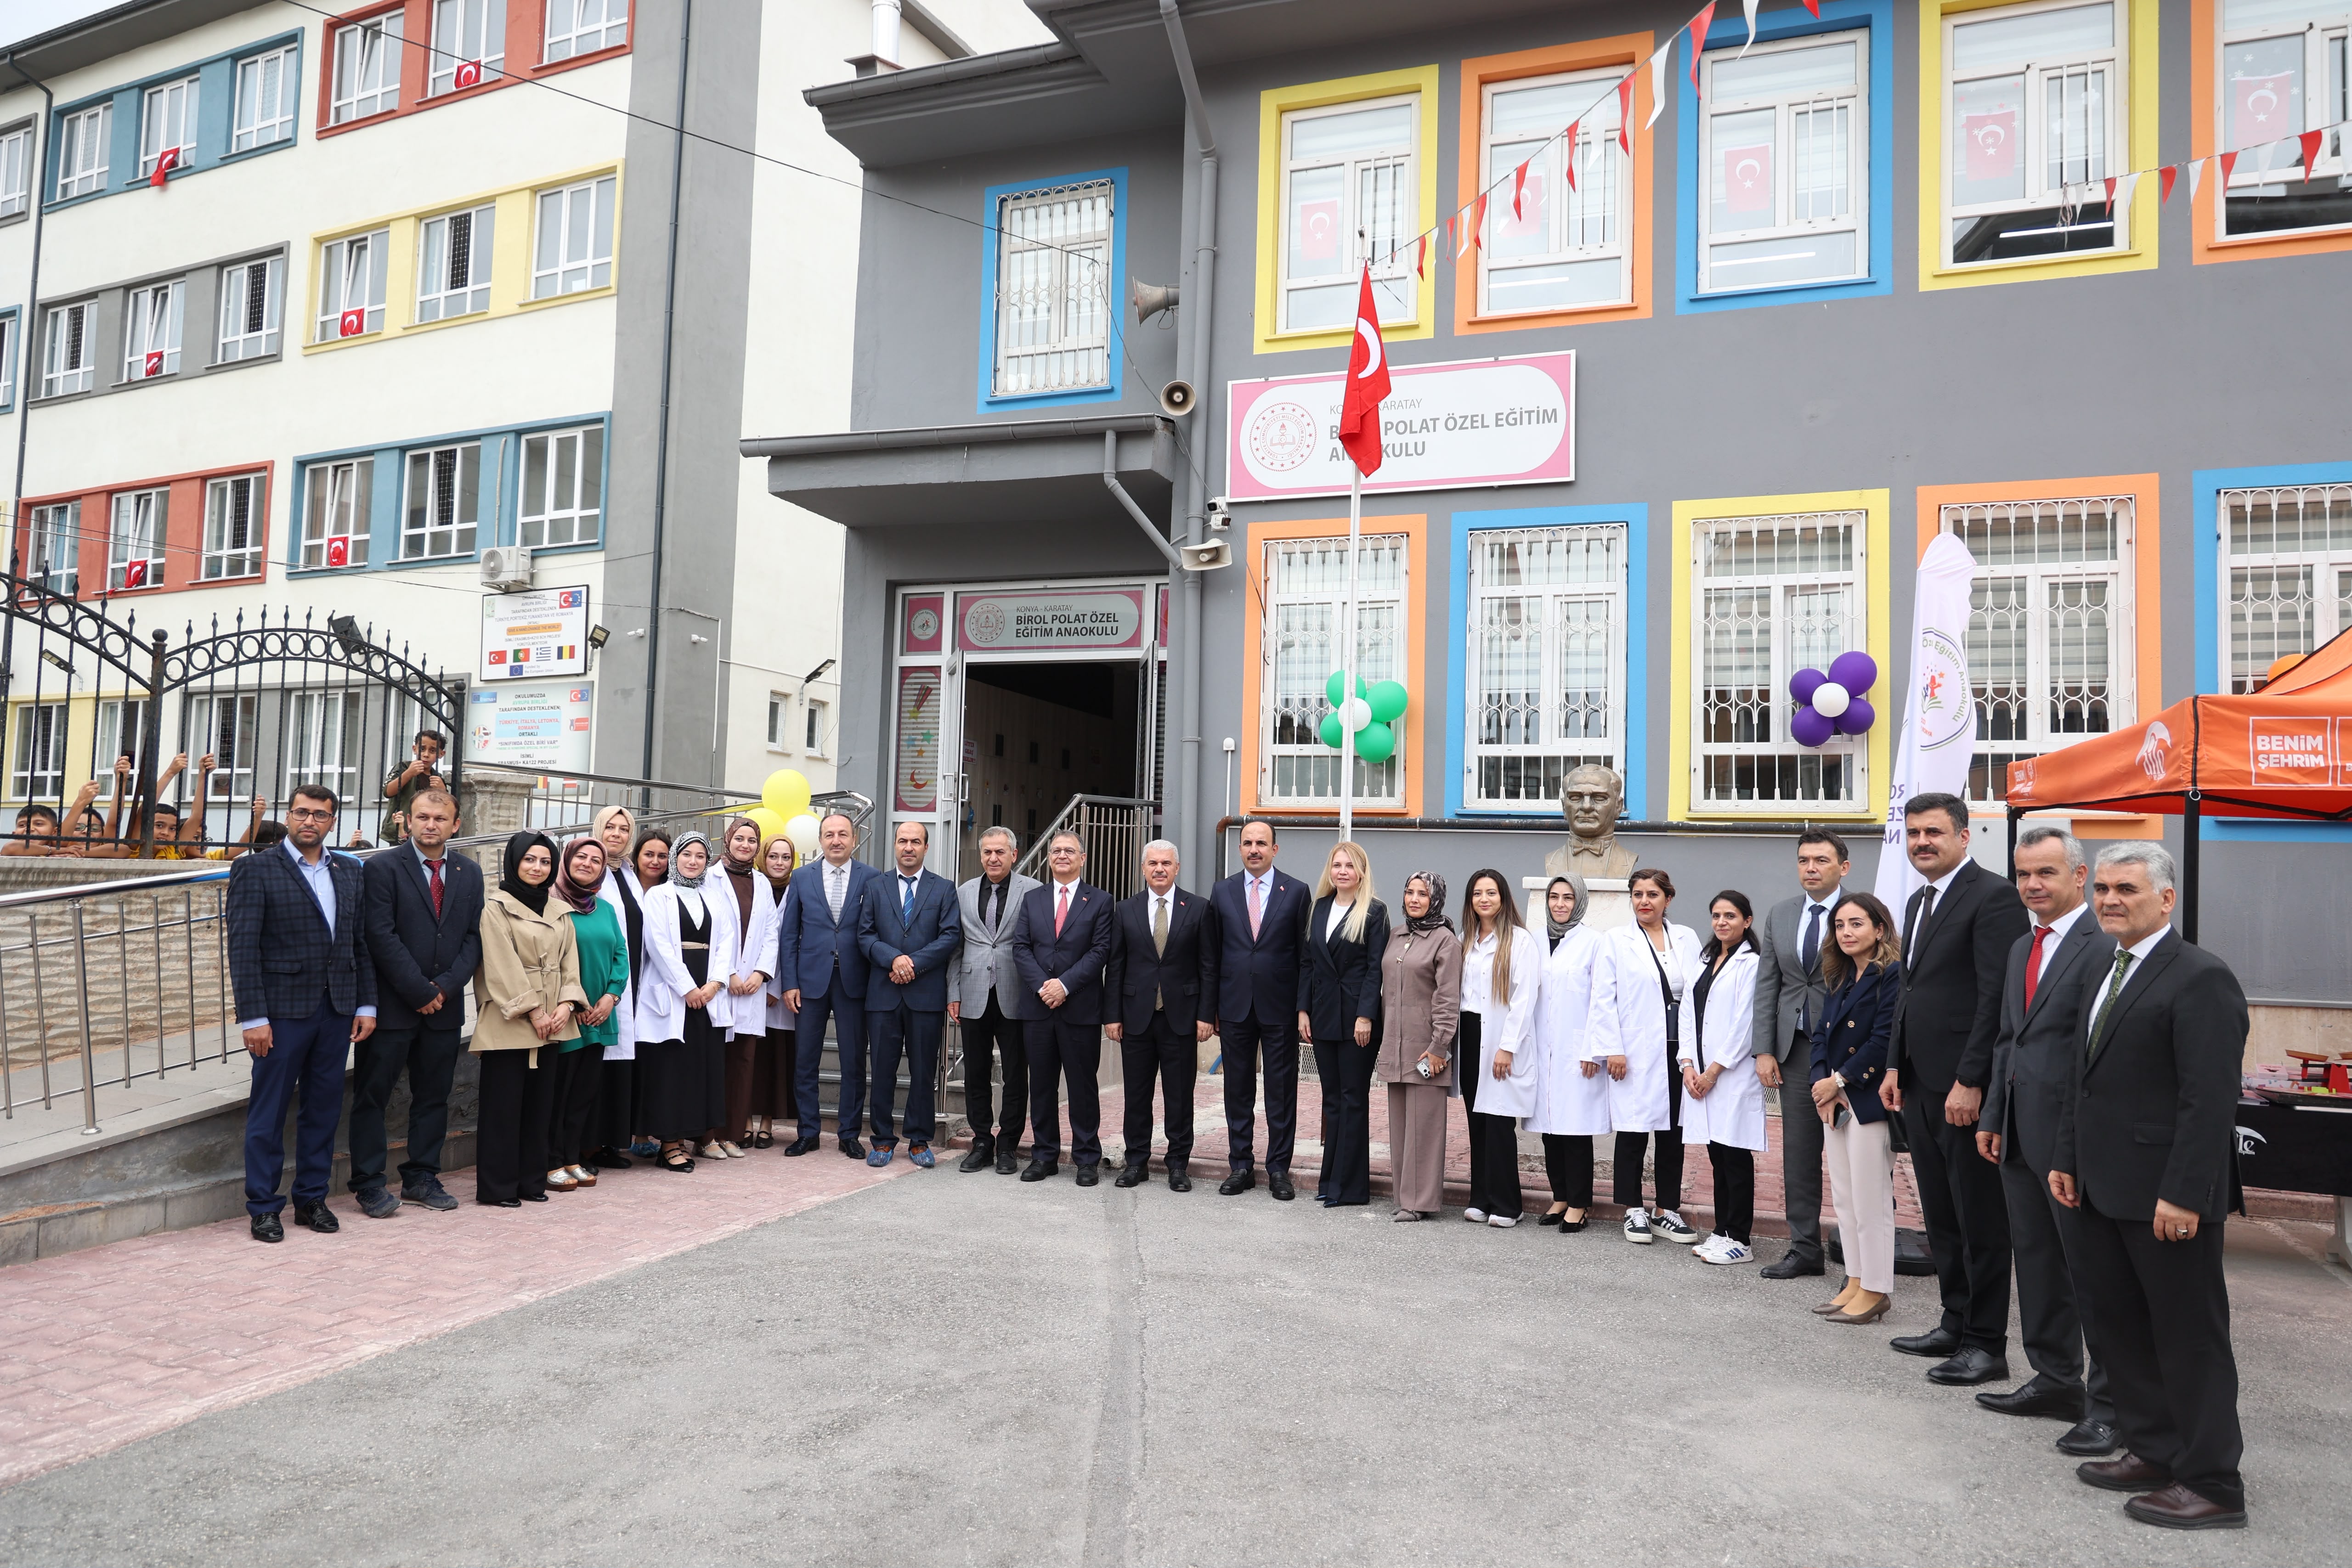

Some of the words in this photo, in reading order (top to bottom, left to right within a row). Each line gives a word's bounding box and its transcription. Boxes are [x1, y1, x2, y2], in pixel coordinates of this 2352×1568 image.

[1384, 417, 1440, 436] POLAT
[1444, 412, 1490, 431] ÖZEL
[1495, 405, 1558, 428] EĞİTİM
[1016, 614, 1048, 625] BİROL
[1052, 614, 1087, 624] POLAT
[1090, 611, 1119, 623] ÖZEL
[1016, 626, 1053, 637] EĞİTİM
[1056, 626, 1119, 637] ANAOKULU
[1934, 641, 1961, 669] Eğitim
[1952, 671, 1967, 722] Anaokulu
